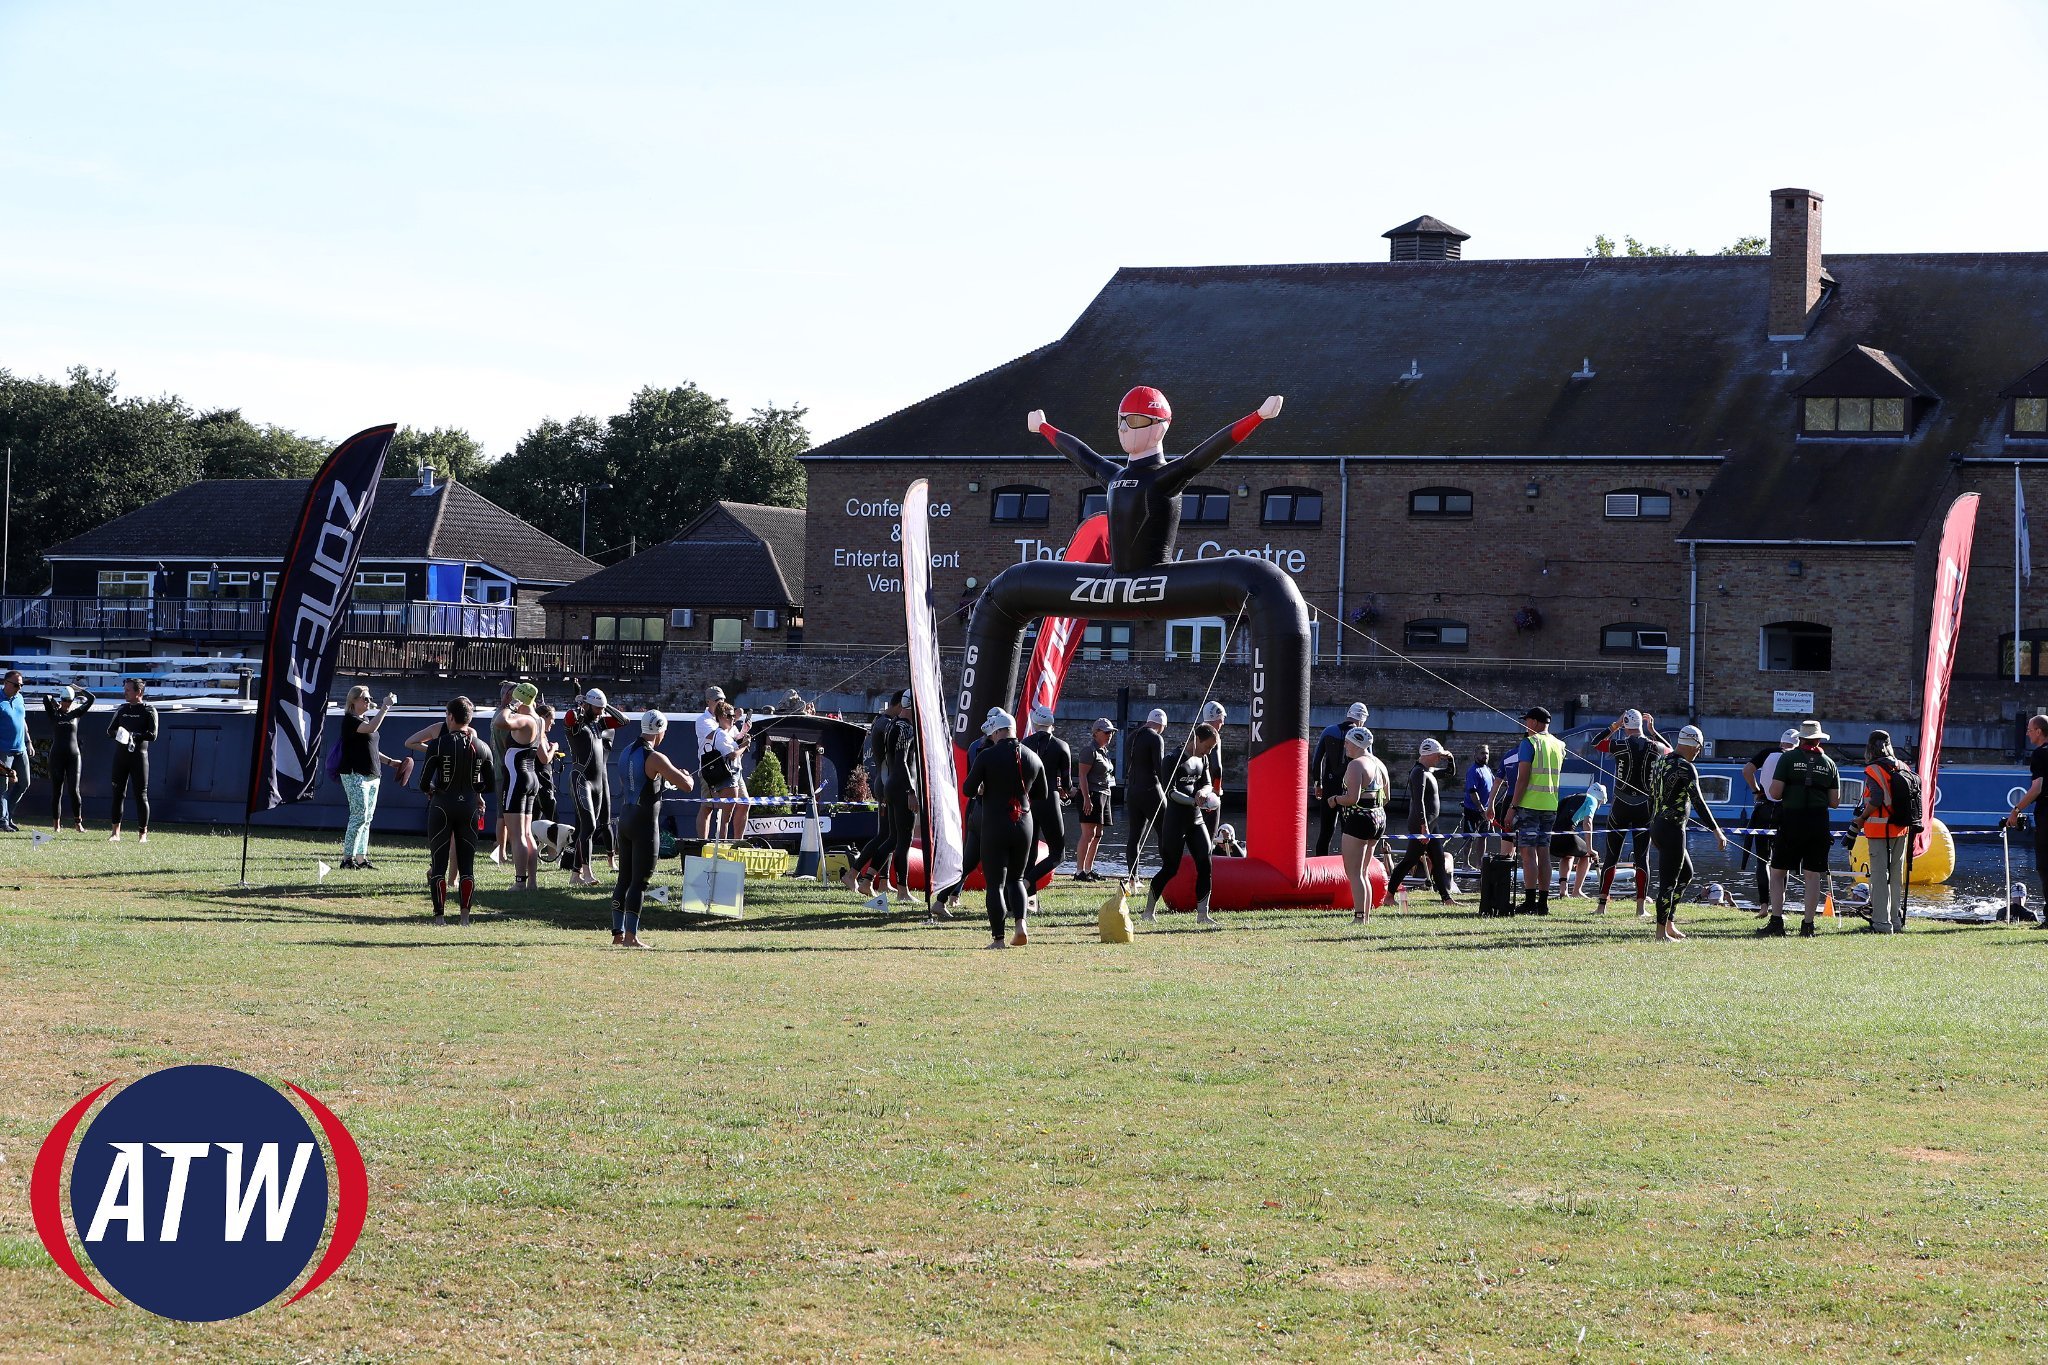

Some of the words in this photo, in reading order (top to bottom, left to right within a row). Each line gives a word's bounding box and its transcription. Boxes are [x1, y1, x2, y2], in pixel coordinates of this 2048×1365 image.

[846, 498, 952, 517] Confece
[890, 523, 902, 542] &
[834, 548, 960, 568] Entertaent
[867, 573, 904, 592] Ven
[955, 645, 979, 734] GOOD
[1251, 647, 1265, 742] LUCK
[443, 755, 451, 783] HUUB
[746, 819, 772, 833] New
[774, 817, 825, 832] Vente
